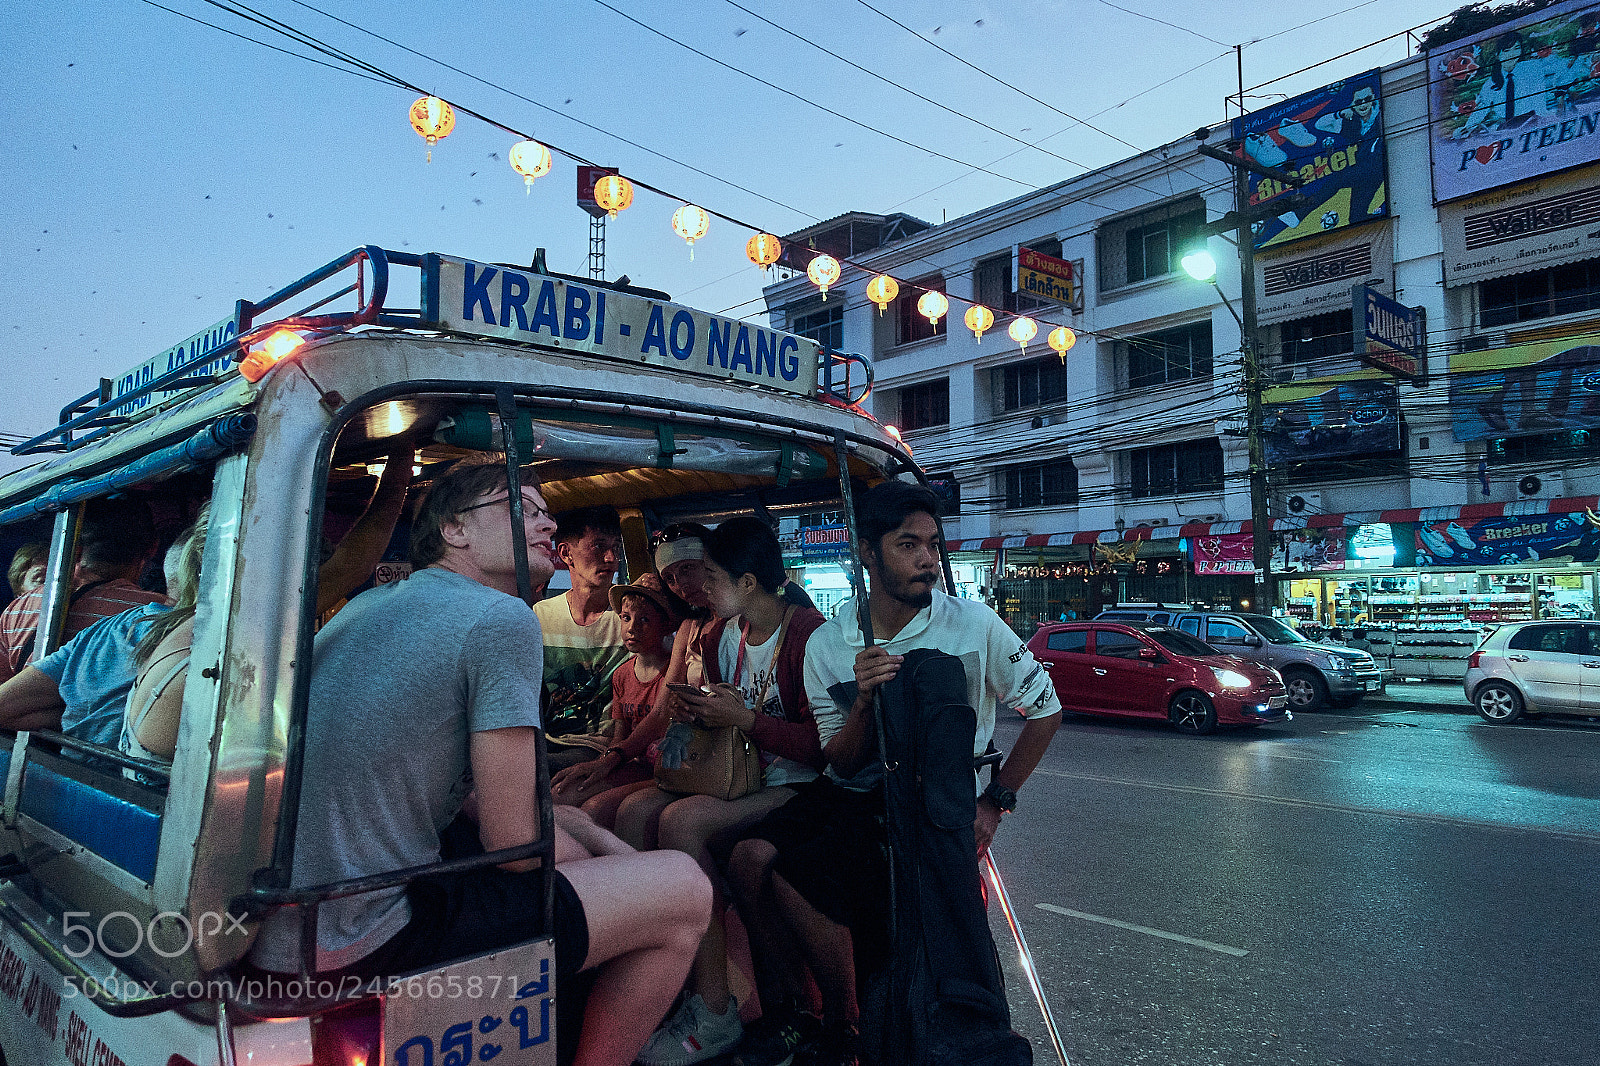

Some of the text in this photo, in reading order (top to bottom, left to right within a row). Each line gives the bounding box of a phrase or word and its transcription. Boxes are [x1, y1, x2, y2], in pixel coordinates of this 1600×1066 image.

[1488, 203, 1580, 238] Walker
[1282, 259, 1351, 286] Walker
[462, 262, 606, 345] KRABI
[641, 304, 696, 361] AO
[706, 316, 800, 382] NANG
[1485, 522, 1549, 540] Breaker
